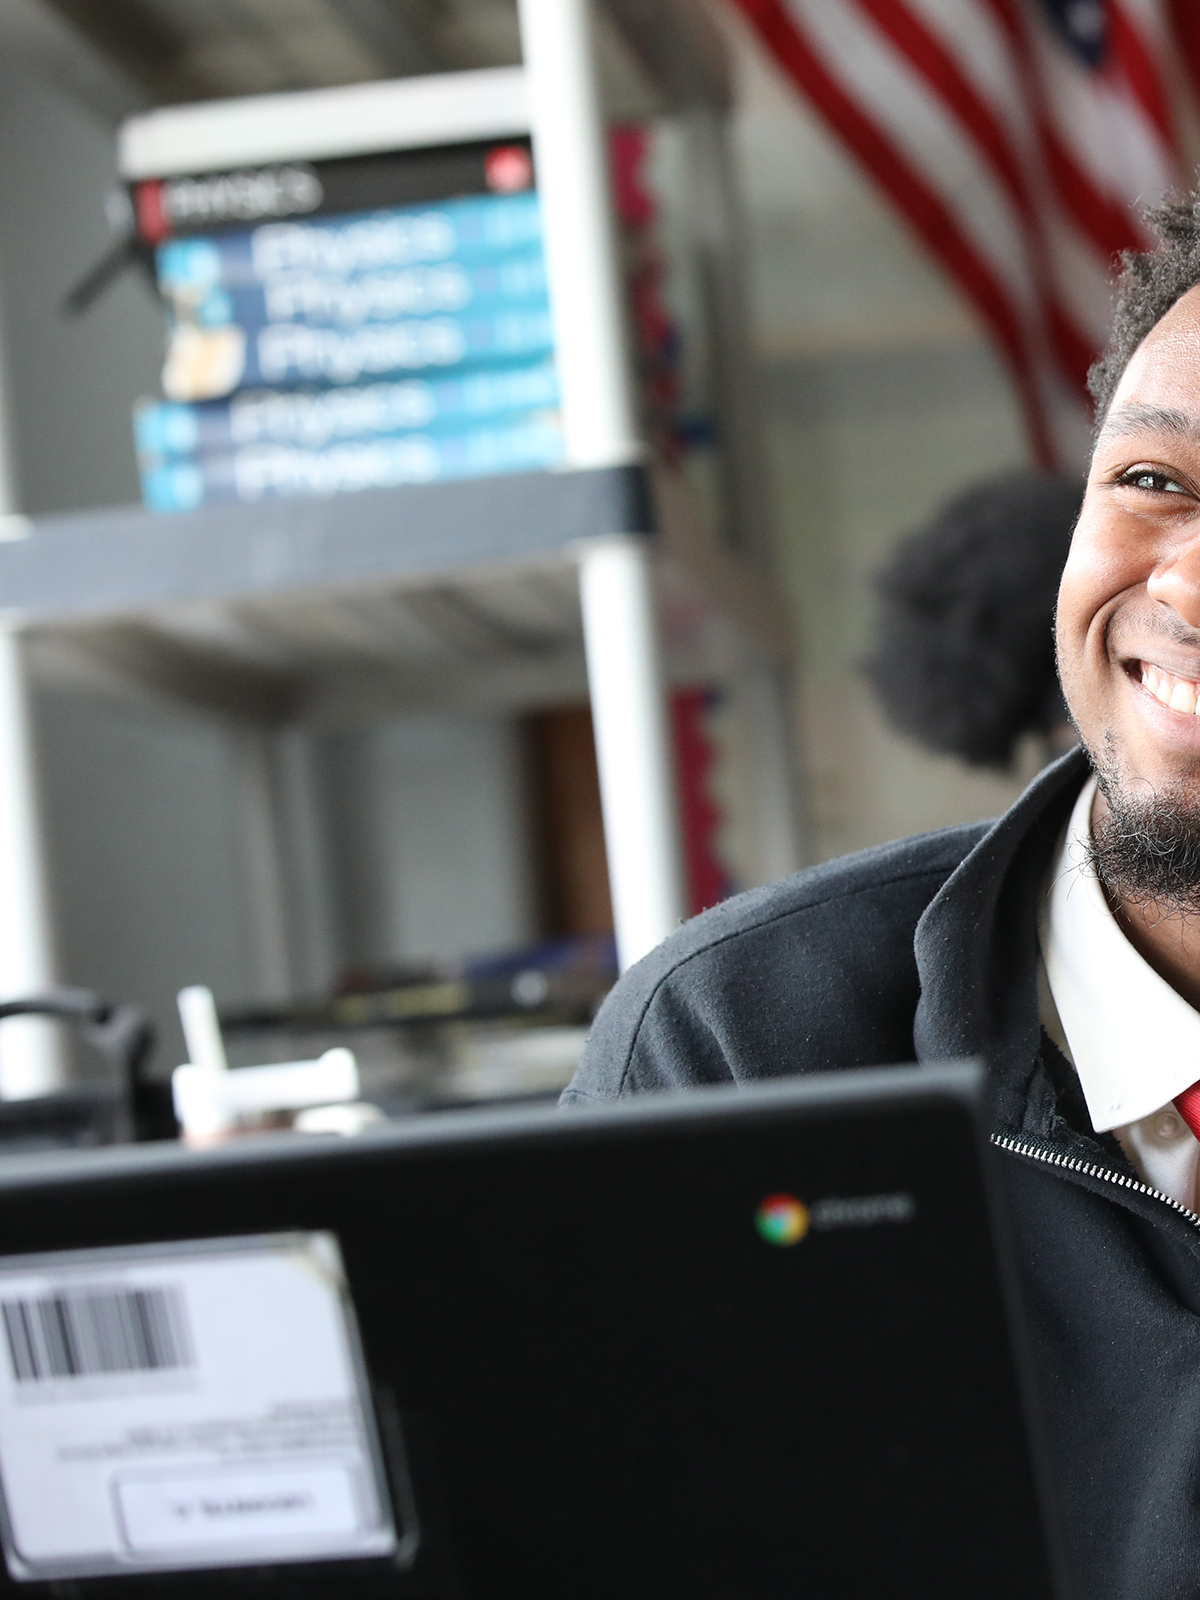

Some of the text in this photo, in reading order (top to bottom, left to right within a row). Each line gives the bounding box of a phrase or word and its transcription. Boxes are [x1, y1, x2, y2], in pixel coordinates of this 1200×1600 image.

[252, 217, 457, 278] Physics
[264, 265, 471, 323] Physics
[257, 319, 466, 380] Physics
[230, 381, 435, 446] Physics
[235, 437, 440, 499] Physics
